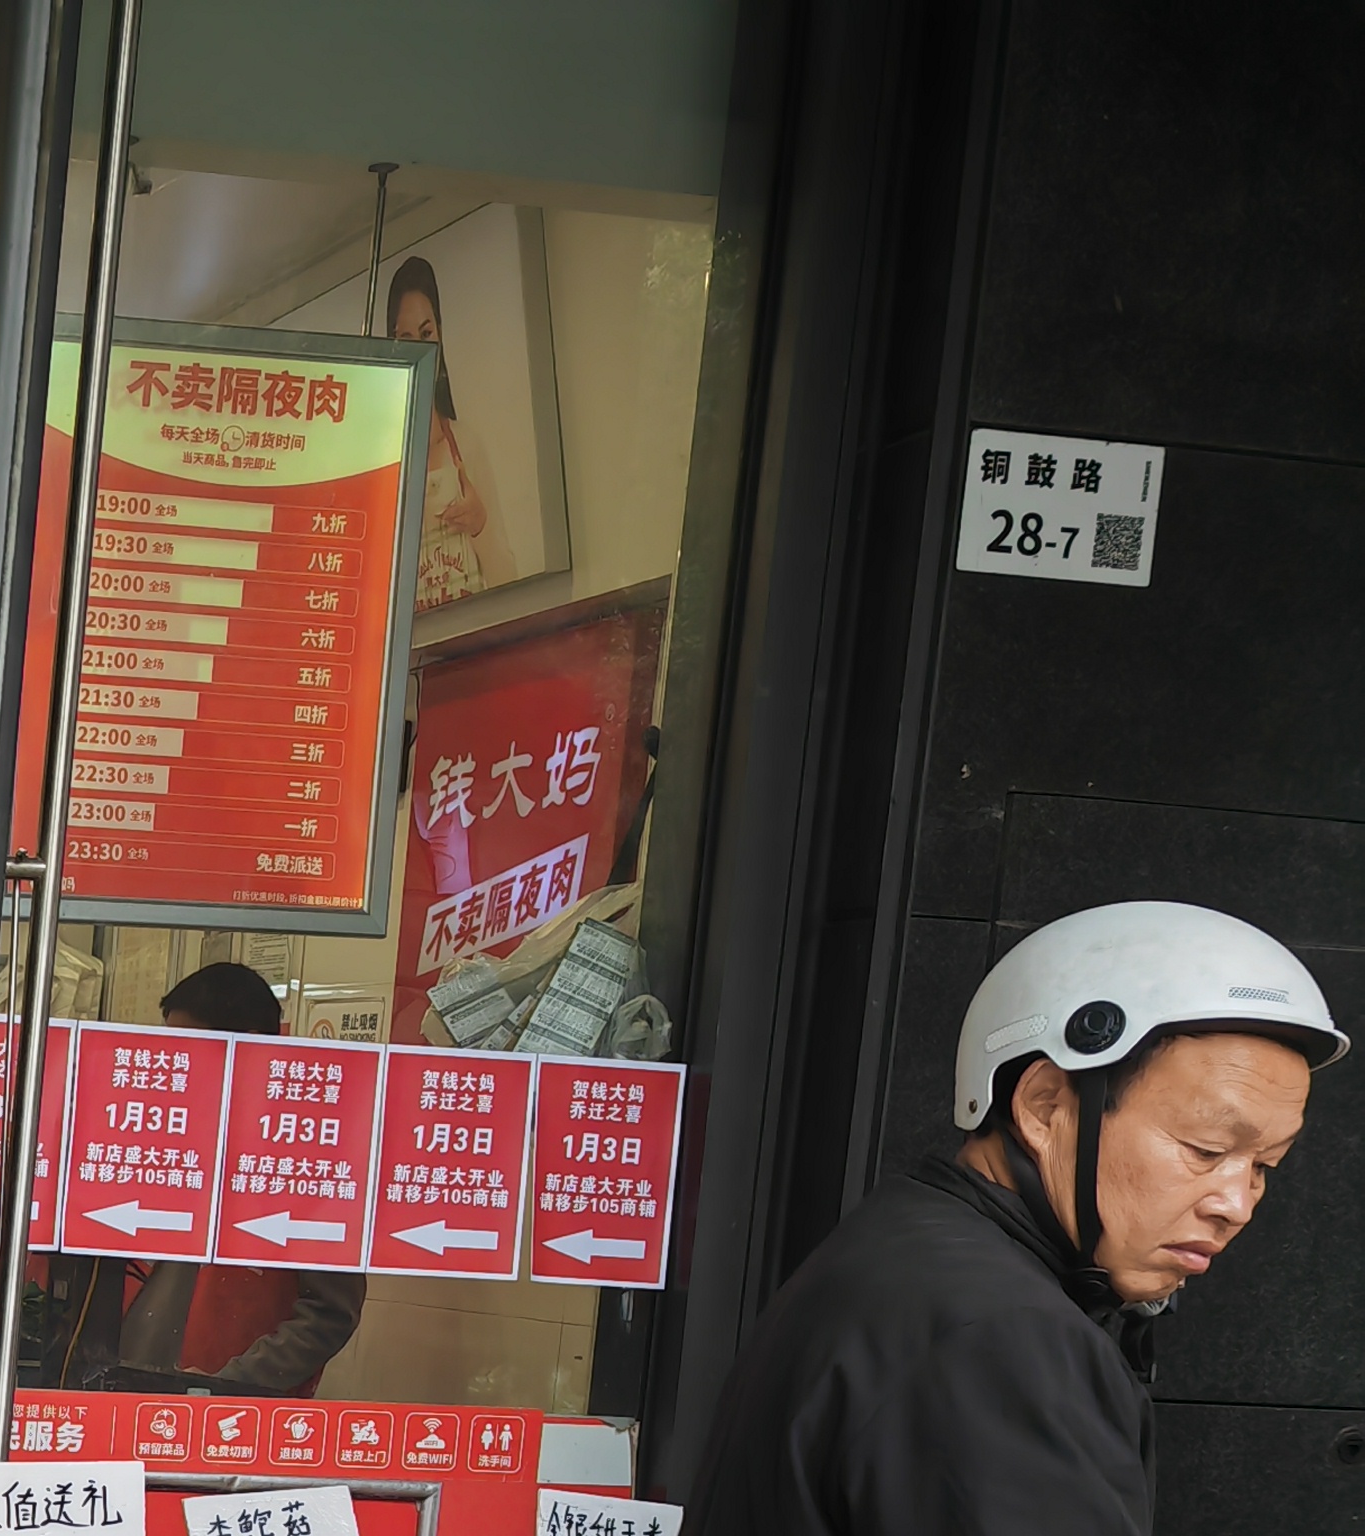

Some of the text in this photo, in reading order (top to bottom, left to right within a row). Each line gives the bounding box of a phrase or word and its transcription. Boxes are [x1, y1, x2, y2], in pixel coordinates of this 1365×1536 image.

[127, 359, 348, 424] 不卖隔夜肉
[160, 423, 306, 452] 每天全场 清货时间
[980, 448, 1103, 495] 铜鼓路
[97, 493, 348, 535] 19:00 全场 九折
[985, 508, 1081, 560] 28-7
[93, 532, 344, 573] 19:30 全场 八折
[90, 571, 340, 612] 20:00 全场 七折
[86, 610, 336, 650] 20:30 全场 六折
[82, 649, 333, 688] 21:00 全场 五折
[79, 686, 329, 725] 21:30 全场 四折
[77, 725, 325, 764] 22:00 全场 三折
[73, 764, 322, 802] 22:30 全场 二折
[426, 726, 602, 831] 钱大妈
[71, 801, 318, 839] 23:00 全场 一折
[67, 840, 324, 877] 23:30 全场 免费派送
[424, 847, 581, 965] 不卖隔夜肉
[340, 1012, 378, 1032] 禁止吸烟
[114, 1047, 191, 1073] 贺钱大妈
[268, 1059, 343, 1084] 贺钱大妈
[112, 1069, 189, 1094] 乔迁之喜
[266, 1080, 341, 1105] 乔迁之喜
[422, 1069, 496, 1094] 贺钱大妈
[572, 1079, 645, 1104] 贺钱大妈
[420, 1090, 494, 1115] 乔迁之喜
[569, 1100, 642, 1125] 乔迁之喜
[104, 1100, 189, 1136] 1月3日
[258, 1113, 341, 1147] 1月3日
[412, 1122, 494, 1156] 1月3日
[562, 1131, 642, 1166] 1月3日
[86, 1141, 200, 1169] 新店盛大开业
[238, 1152, 353, 1181] 新店盛大开业
[78, 1162, 205, 1191] 请移步105商铺
[230, 1173, 358, 1201] 请移步105商铺
[393, 1163, 505, 1189] 新店盛大开业
[545, 1172, 653, 1198] 新店盛大开业
[385, 1183, 510, 1210] 请移步105商铺
[539, 1191, 658, 1218] 请移步105商铺
[138, 1442, 186, 1457] 预留菜品
[205, 1444, 253, 1459] 免费切割
[278, 1446, 315, 1461] 退换货
[340, 1449, 387, 1464] 送货上门
[405, 1451, 453, 1466] 免费WIFI
[477, 1453, 512, 1469] 洗手间
